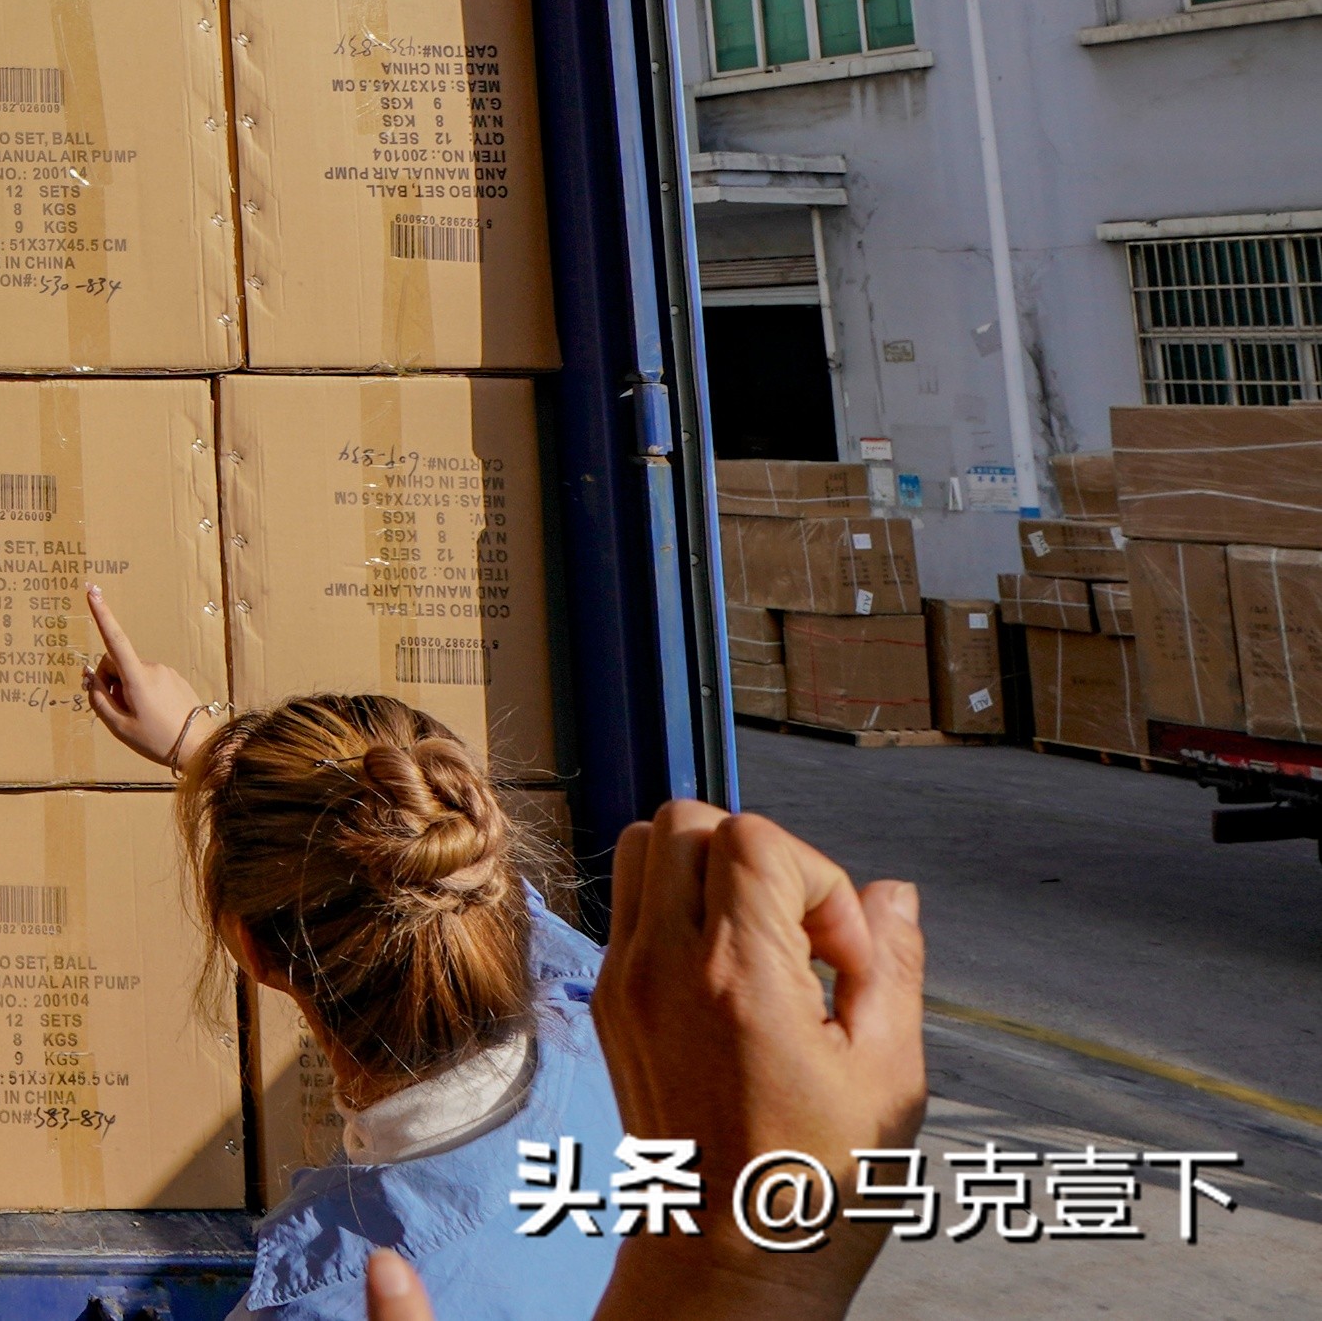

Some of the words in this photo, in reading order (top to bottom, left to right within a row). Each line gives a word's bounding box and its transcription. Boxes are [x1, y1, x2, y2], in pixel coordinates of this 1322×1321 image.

[416, 44, 497, 57] CARTON#:
[60, 150, 88, 162] AIR
[91, 150, 137, 163] PUMP
[323, 165, 368, 178] PUMP
[371, 166, 399, 179] AIR
[401, 166, 469, 179] MANUAL
[472, 167, 507, 179] AND
[39, 276, 122, 304] 530-834
[13, 671, 66, 685] CHINA
[32, 995, 89, 1009] 200104
[34, 1107, 116, 1139] 583-834
